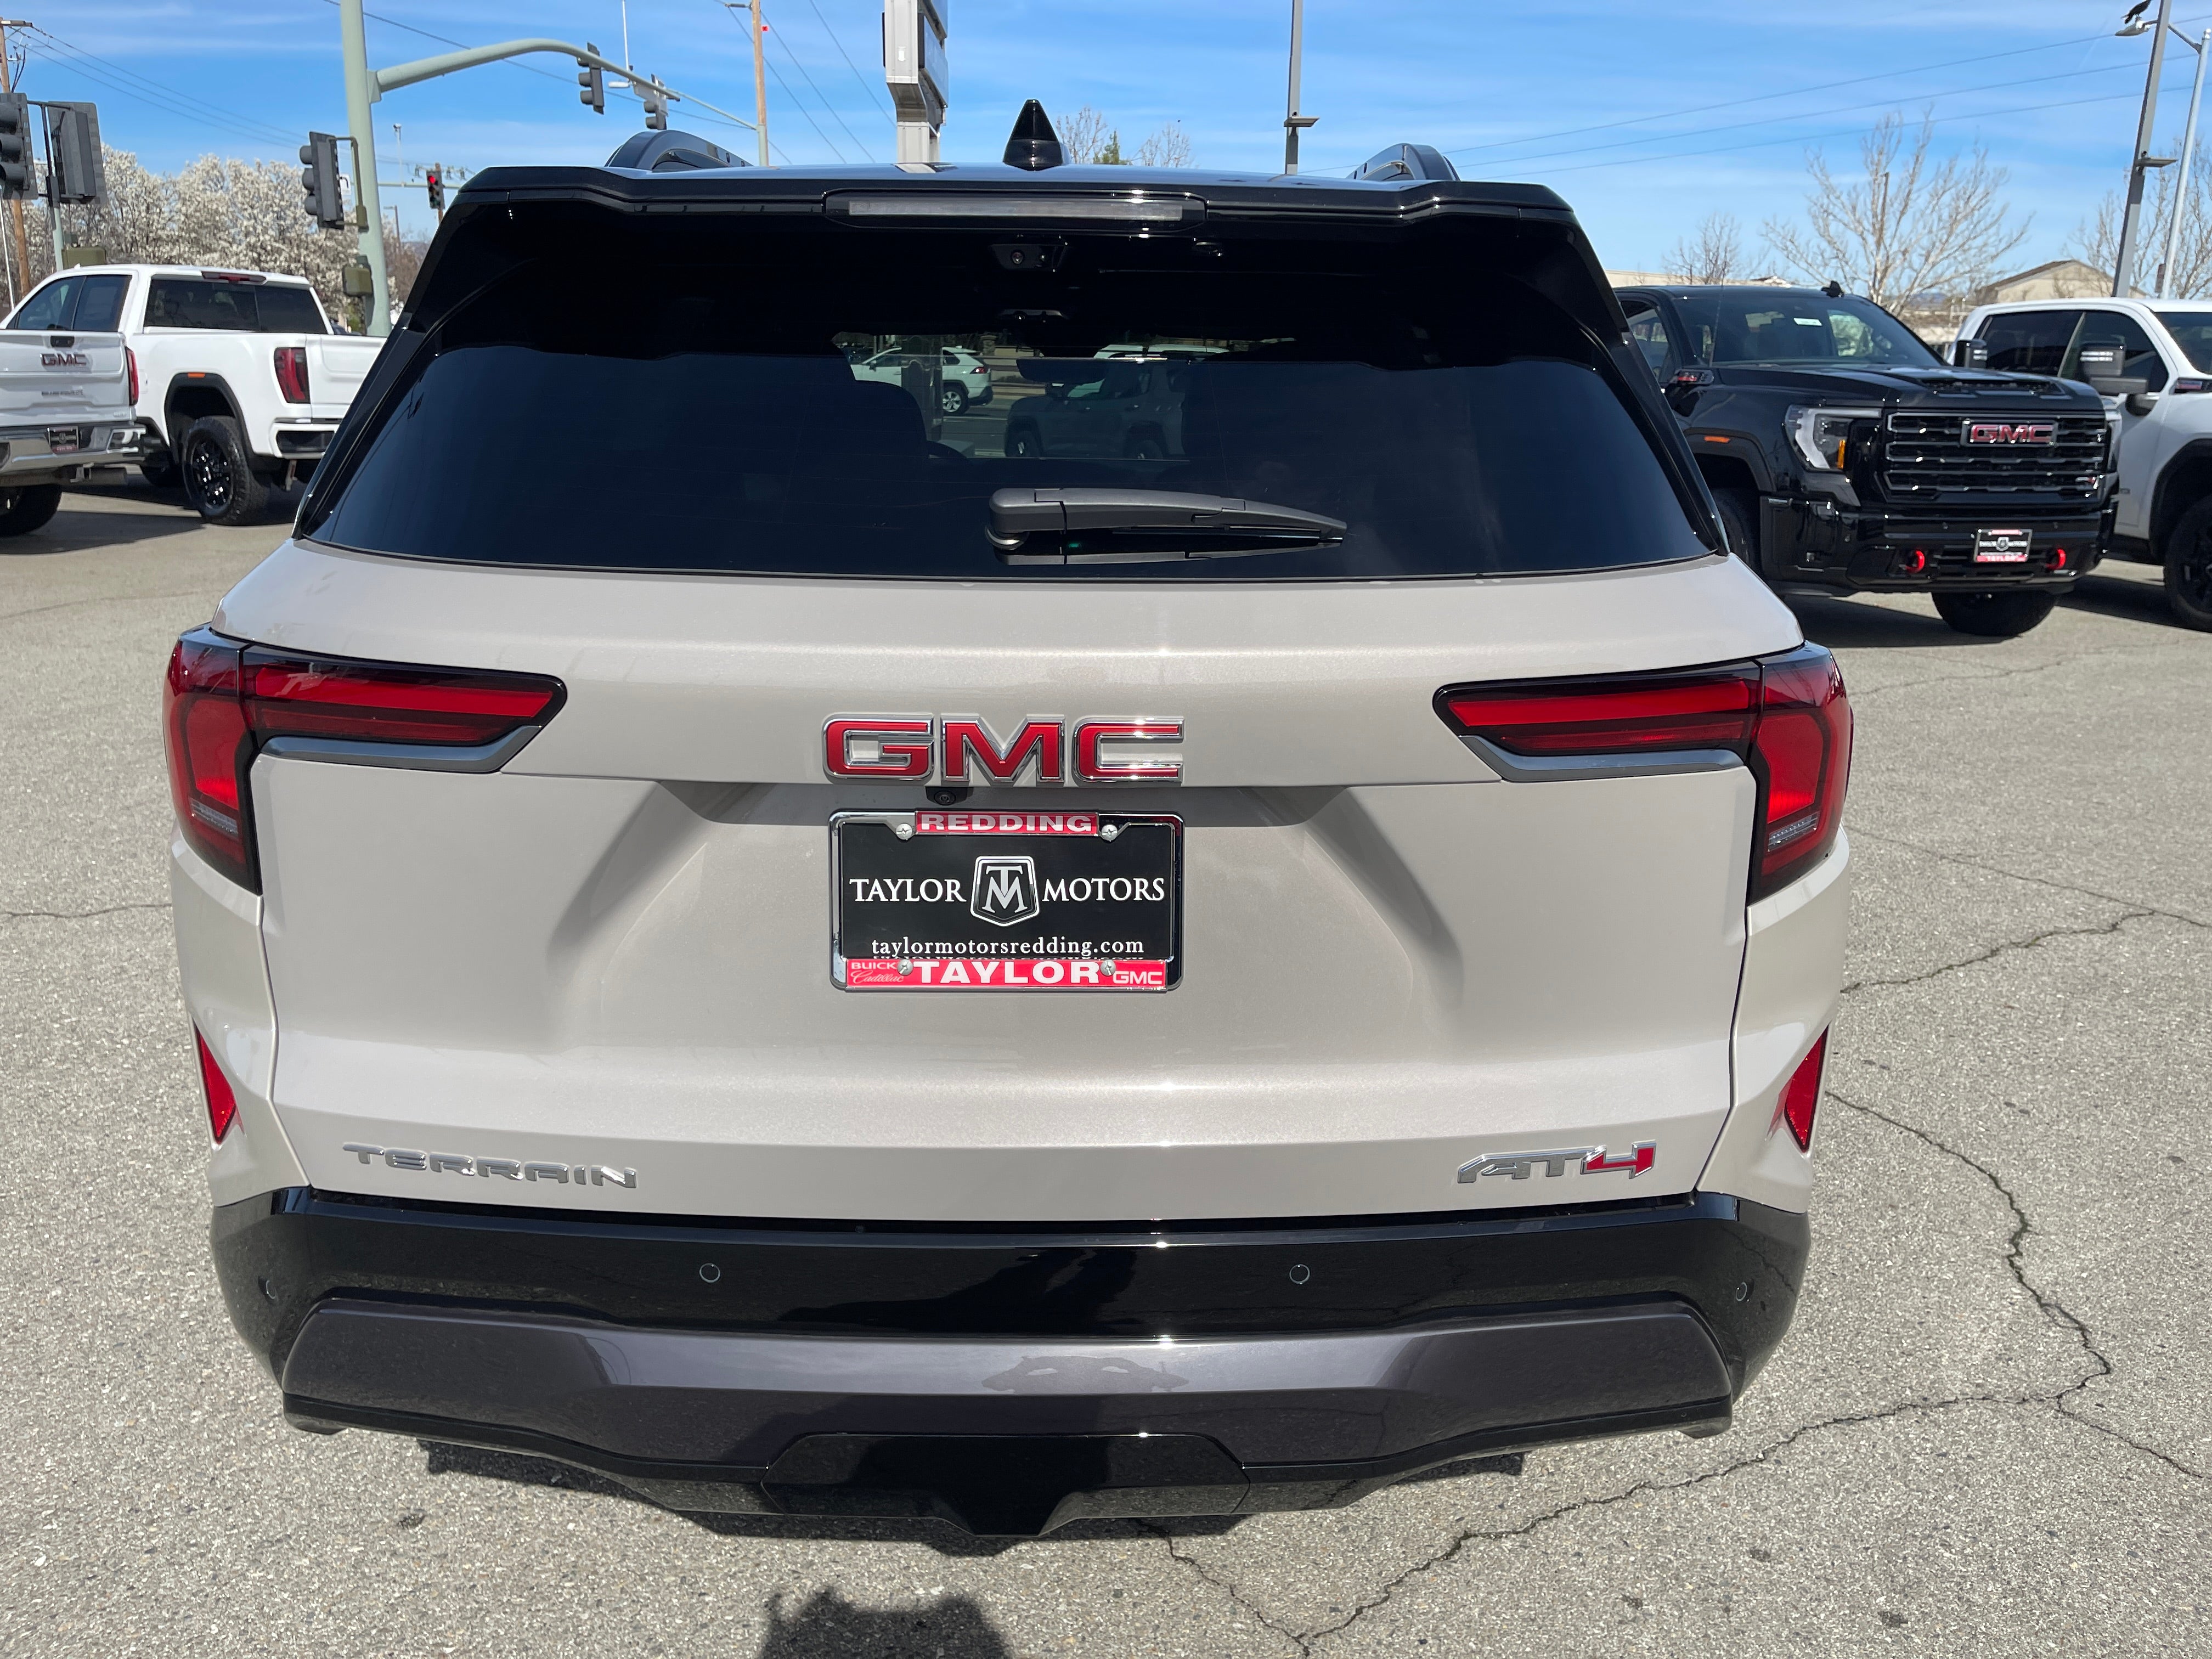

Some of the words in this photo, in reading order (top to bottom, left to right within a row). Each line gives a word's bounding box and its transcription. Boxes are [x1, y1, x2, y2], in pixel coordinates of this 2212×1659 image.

[40, 353, 87, 366] GMC
[1971, 424, 2053, 443] GMC
[823, 713, 1184, 782] GMC
[921, 814, 1092, 832] REDDING
[850, 878, 966, 902] TAYLOR
[1042, 878, 1165, 901] MOTORS
[871, 936, 1144, 957] taylormotorsredding.com
[850, 970, 905, 984] Cadillac
[913, 961, 1099, 984] TAYLOR
[1114, 970, 1163, 984] GMC
[342, 1142, 636, 1188] TERRAIN
[1457, 1139, 1657, 1183] AT4
